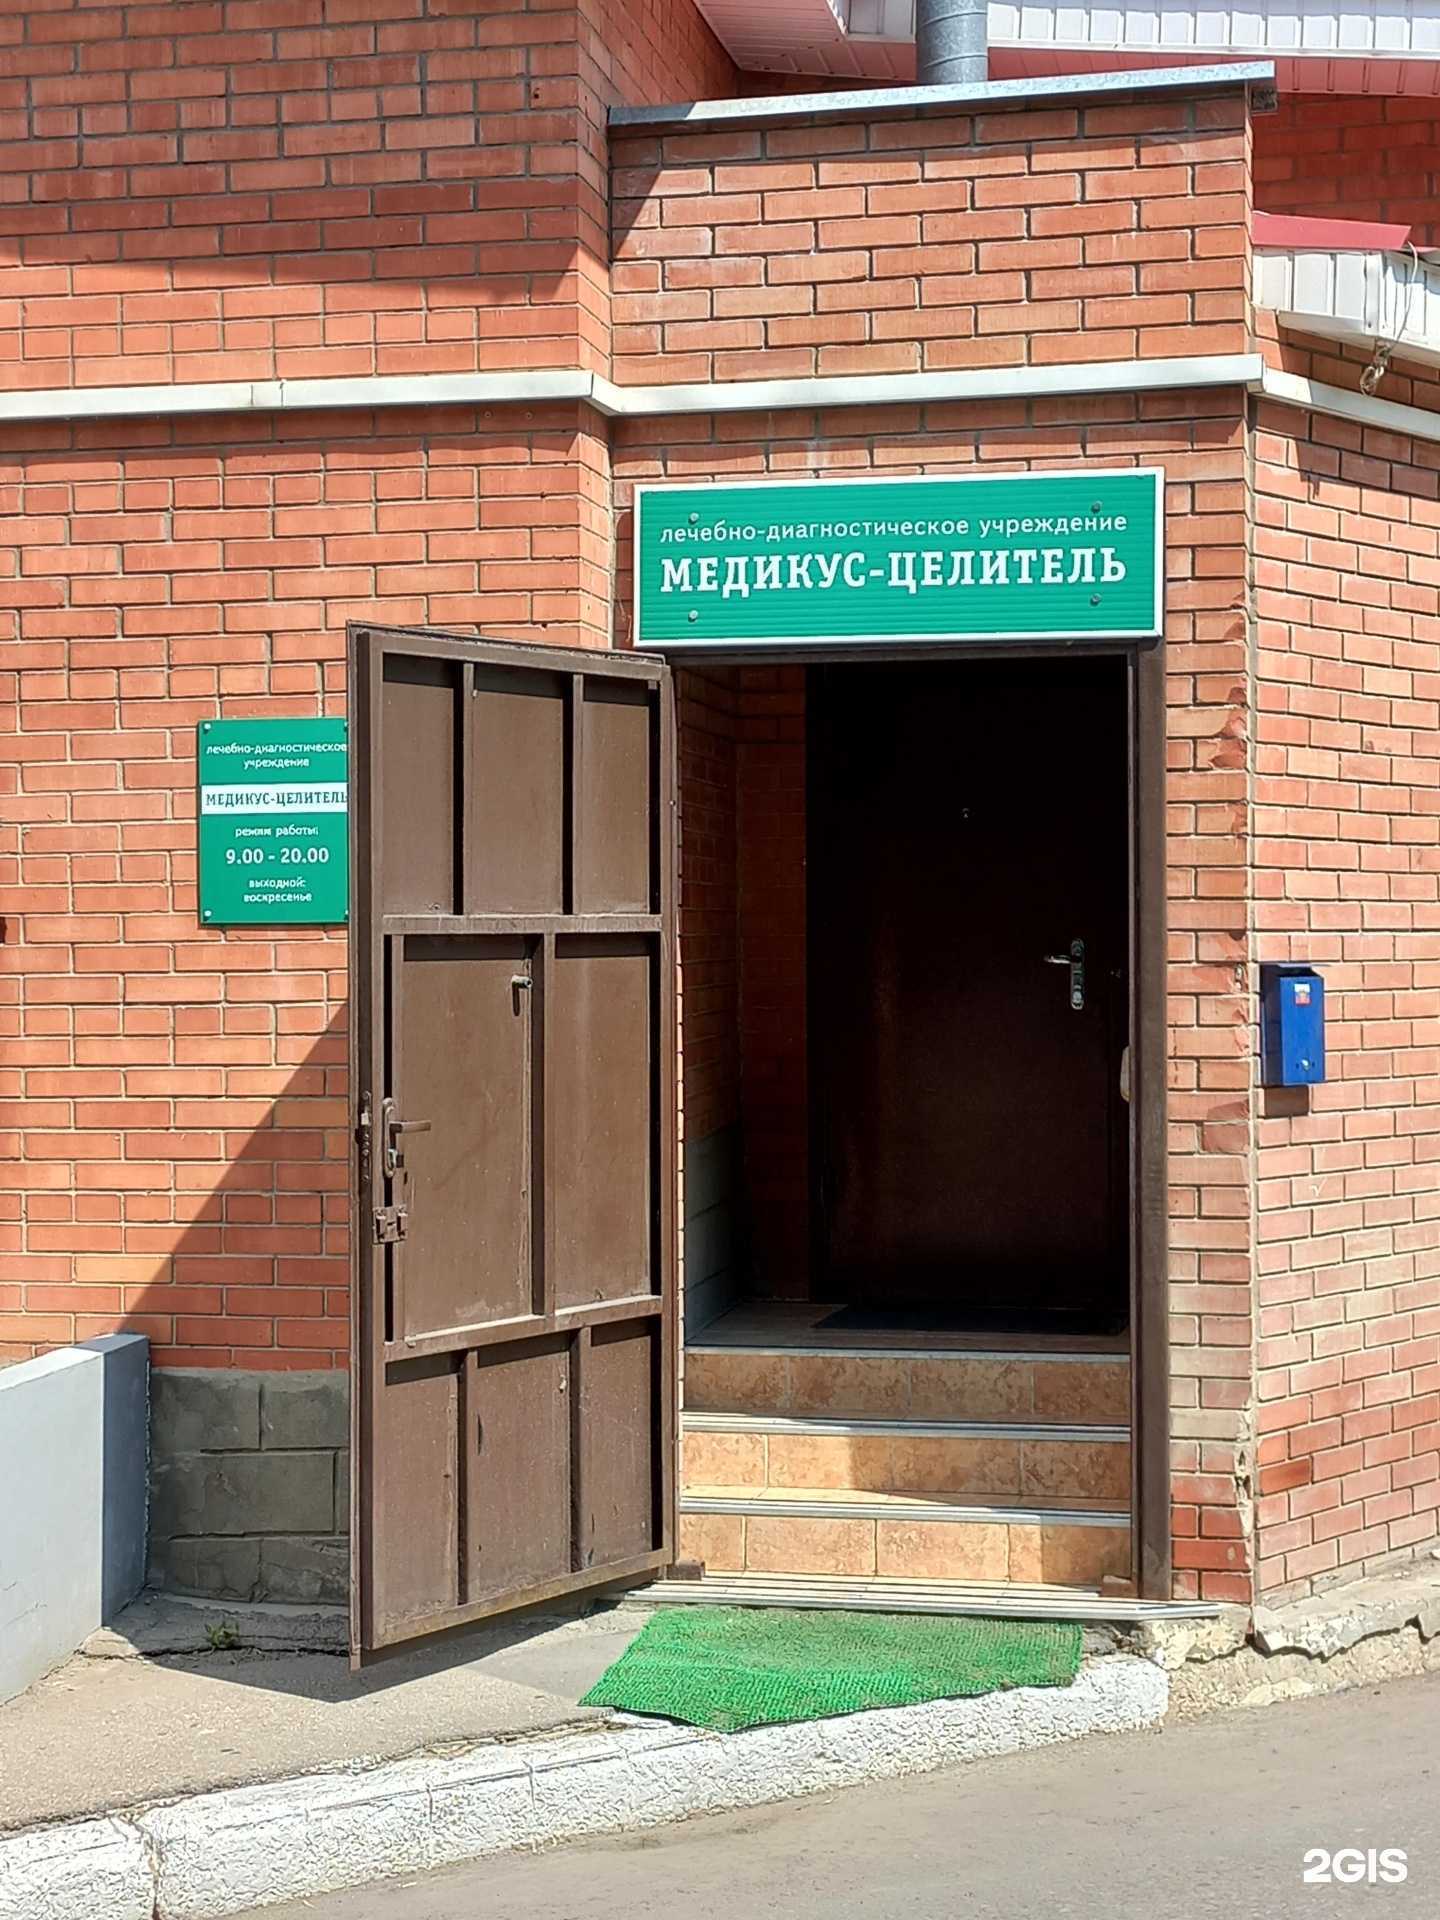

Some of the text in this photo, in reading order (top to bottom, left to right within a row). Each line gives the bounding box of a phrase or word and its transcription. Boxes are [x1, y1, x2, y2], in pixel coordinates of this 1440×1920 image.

[659, 512, 1128, 544] лечебно-диагностическое учреждение
[660, 546, 1127, 598] МЕДИКУС-ЦЕЛИТЕЛЬ
[206, 742, 347, 755] лечебно-диагностическое
[243, 757, 310, 769] учреждение
[235, 826, 272, 837] режим
[225, 848, 264, 864] 9.00
[280, 847, 330, 863] 20.00
[243, 892, 312, 903] воскресенье
